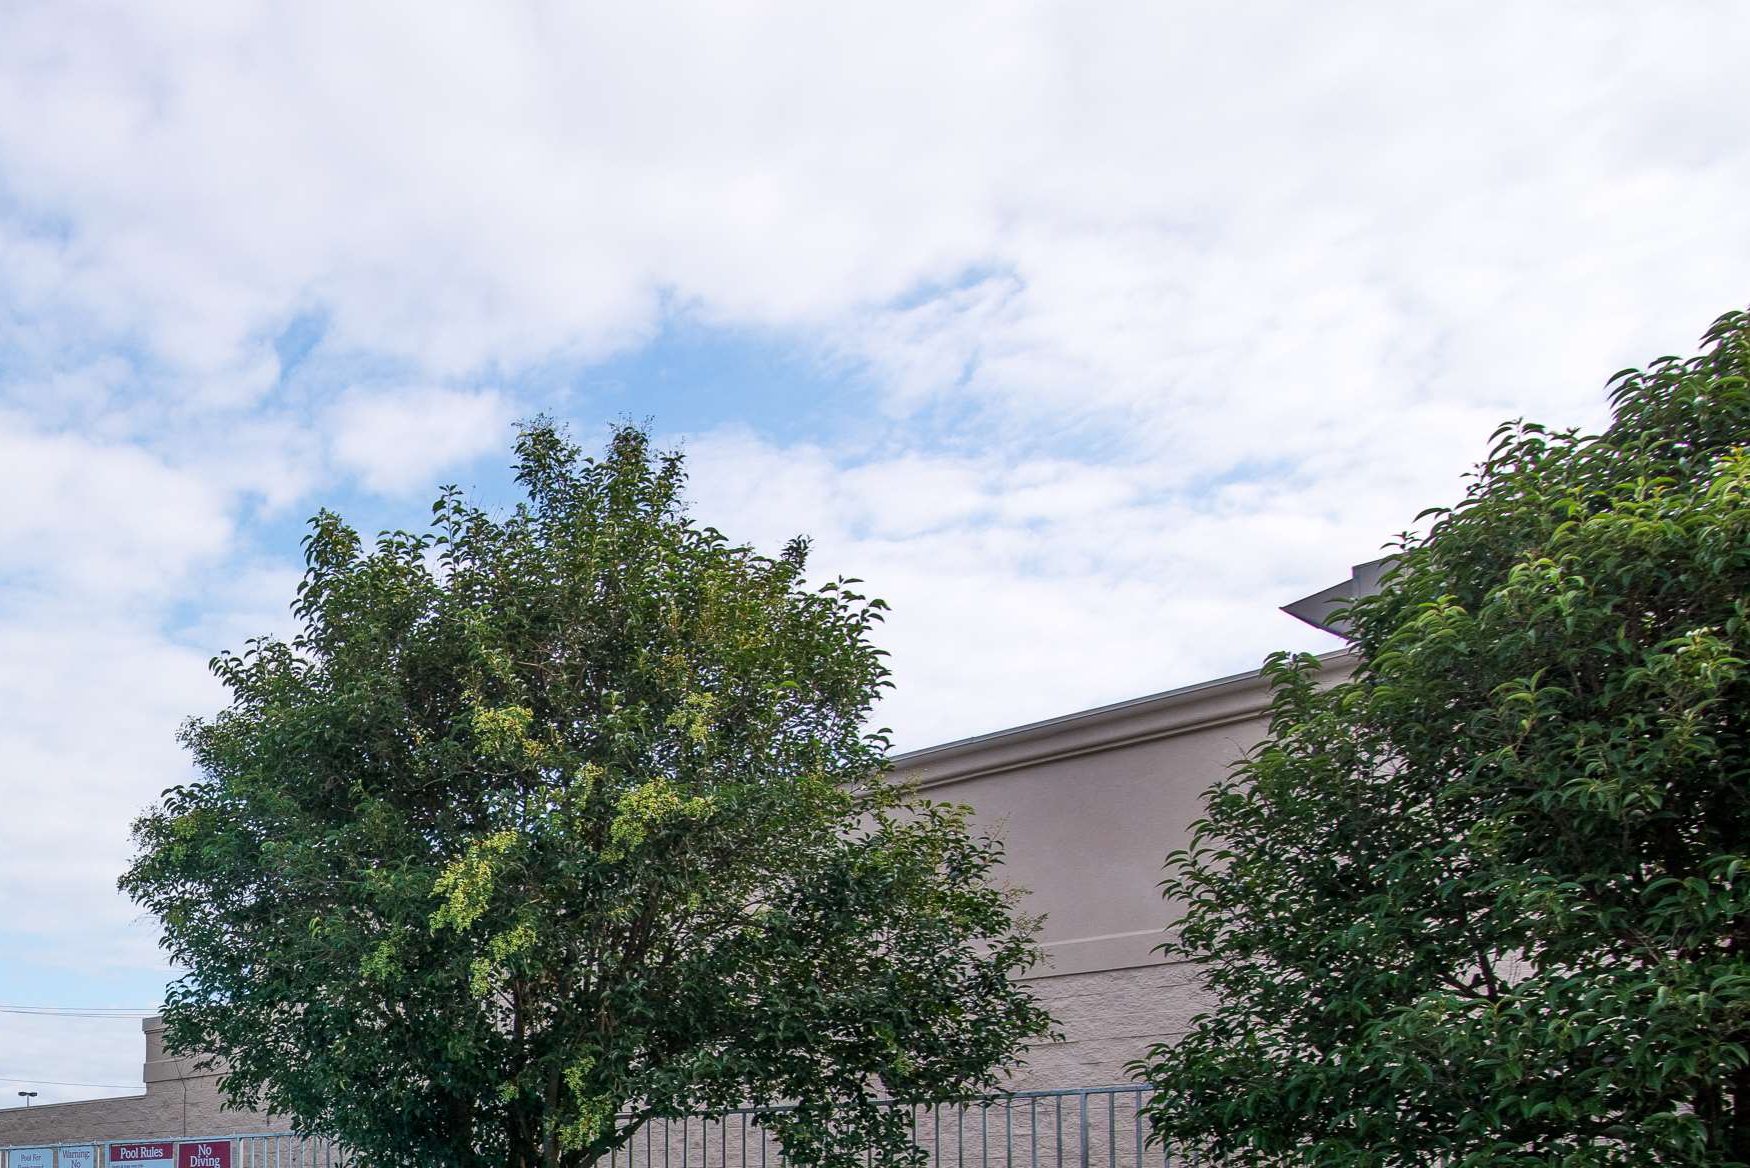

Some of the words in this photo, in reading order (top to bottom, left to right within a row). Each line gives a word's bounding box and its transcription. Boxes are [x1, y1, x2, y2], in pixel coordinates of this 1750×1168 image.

[120, 1147, 139, 1160] Pool
[140, 1146, 164, 1158] Rules
[197, 1143, 212, 1156] No
[20, 1153, 32, 1162] Pool
[32, 1153, 42, 1162] For
[71, 1160, 82, 1168] No
[190, 1155, 221, 1168] Diving
